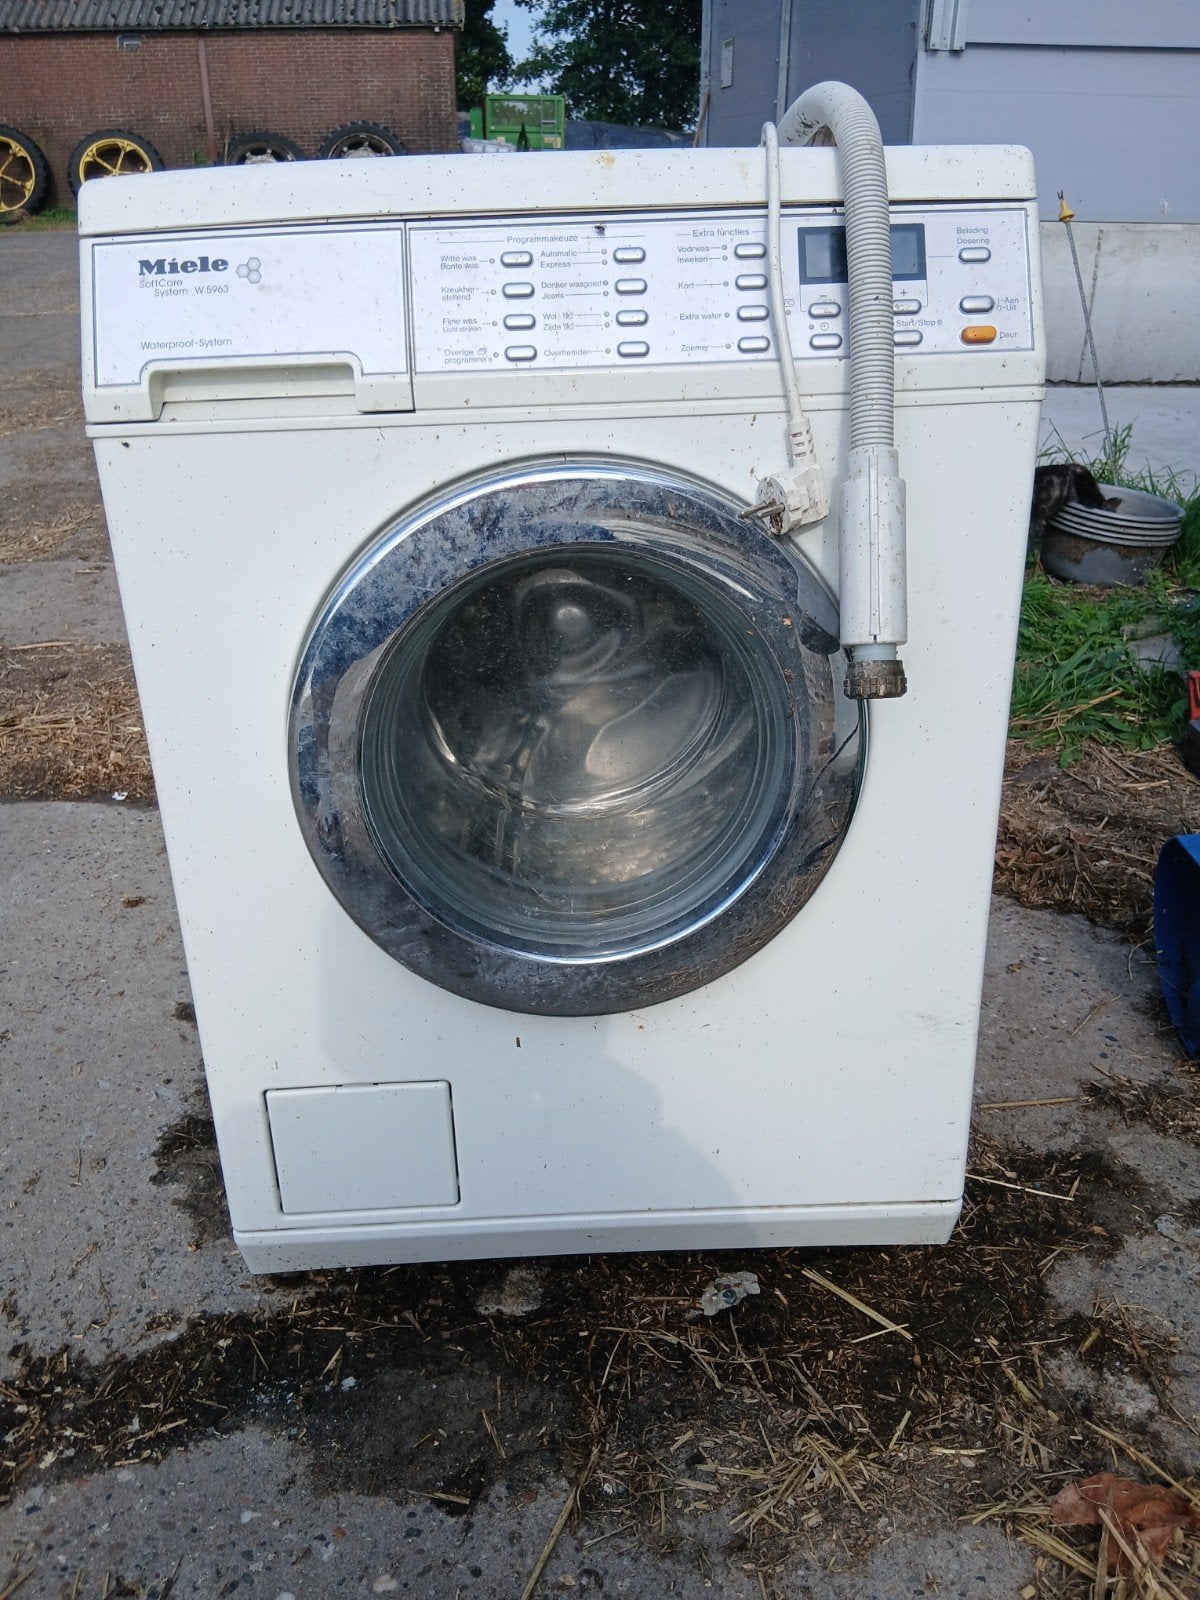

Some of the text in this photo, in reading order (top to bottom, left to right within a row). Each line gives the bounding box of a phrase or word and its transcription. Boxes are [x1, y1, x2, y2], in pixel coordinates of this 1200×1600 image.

[692, 228, 750, 237] Extra functies
[957, 227, 989, 235] Belading
[506, 234, 578, 245] Programmakeuze
[957, 237, 990, 245] Dosering
[540, 249, 578, 257] Automatic
[440, 255, 460, 263] Witte
[677, 255, 709, 263] Inweken
[138, 256, 229, 276] Miele
[440, 262, 463, 270] Bonte
[540, 260, 572, 269] Express
[139, 278, 183, 289] SoftCare
[541, 280, 602, 289] Donker wasgoed
[154, 285, 229, 297] System W 5963
[542, 291, 565, 300] Jeans
[442, 293, 471, 301] stellend
[679, 312, 722, 321] Extra water
[442, 317, 461, 326] Fijne
[896, 318, 936, 327] Start/Stop
[543, 322, 562, 332] Zijde
[999, 331, 1018, 339] Deur
[140, 337, 232, 351] Waterproof-System
[681, 343, 710, 352] Zoemer
[444, 348, 474, 358] Overige
[544, 347, 592, 357] Overhemden
[444, 355, 493, 365] programma's
